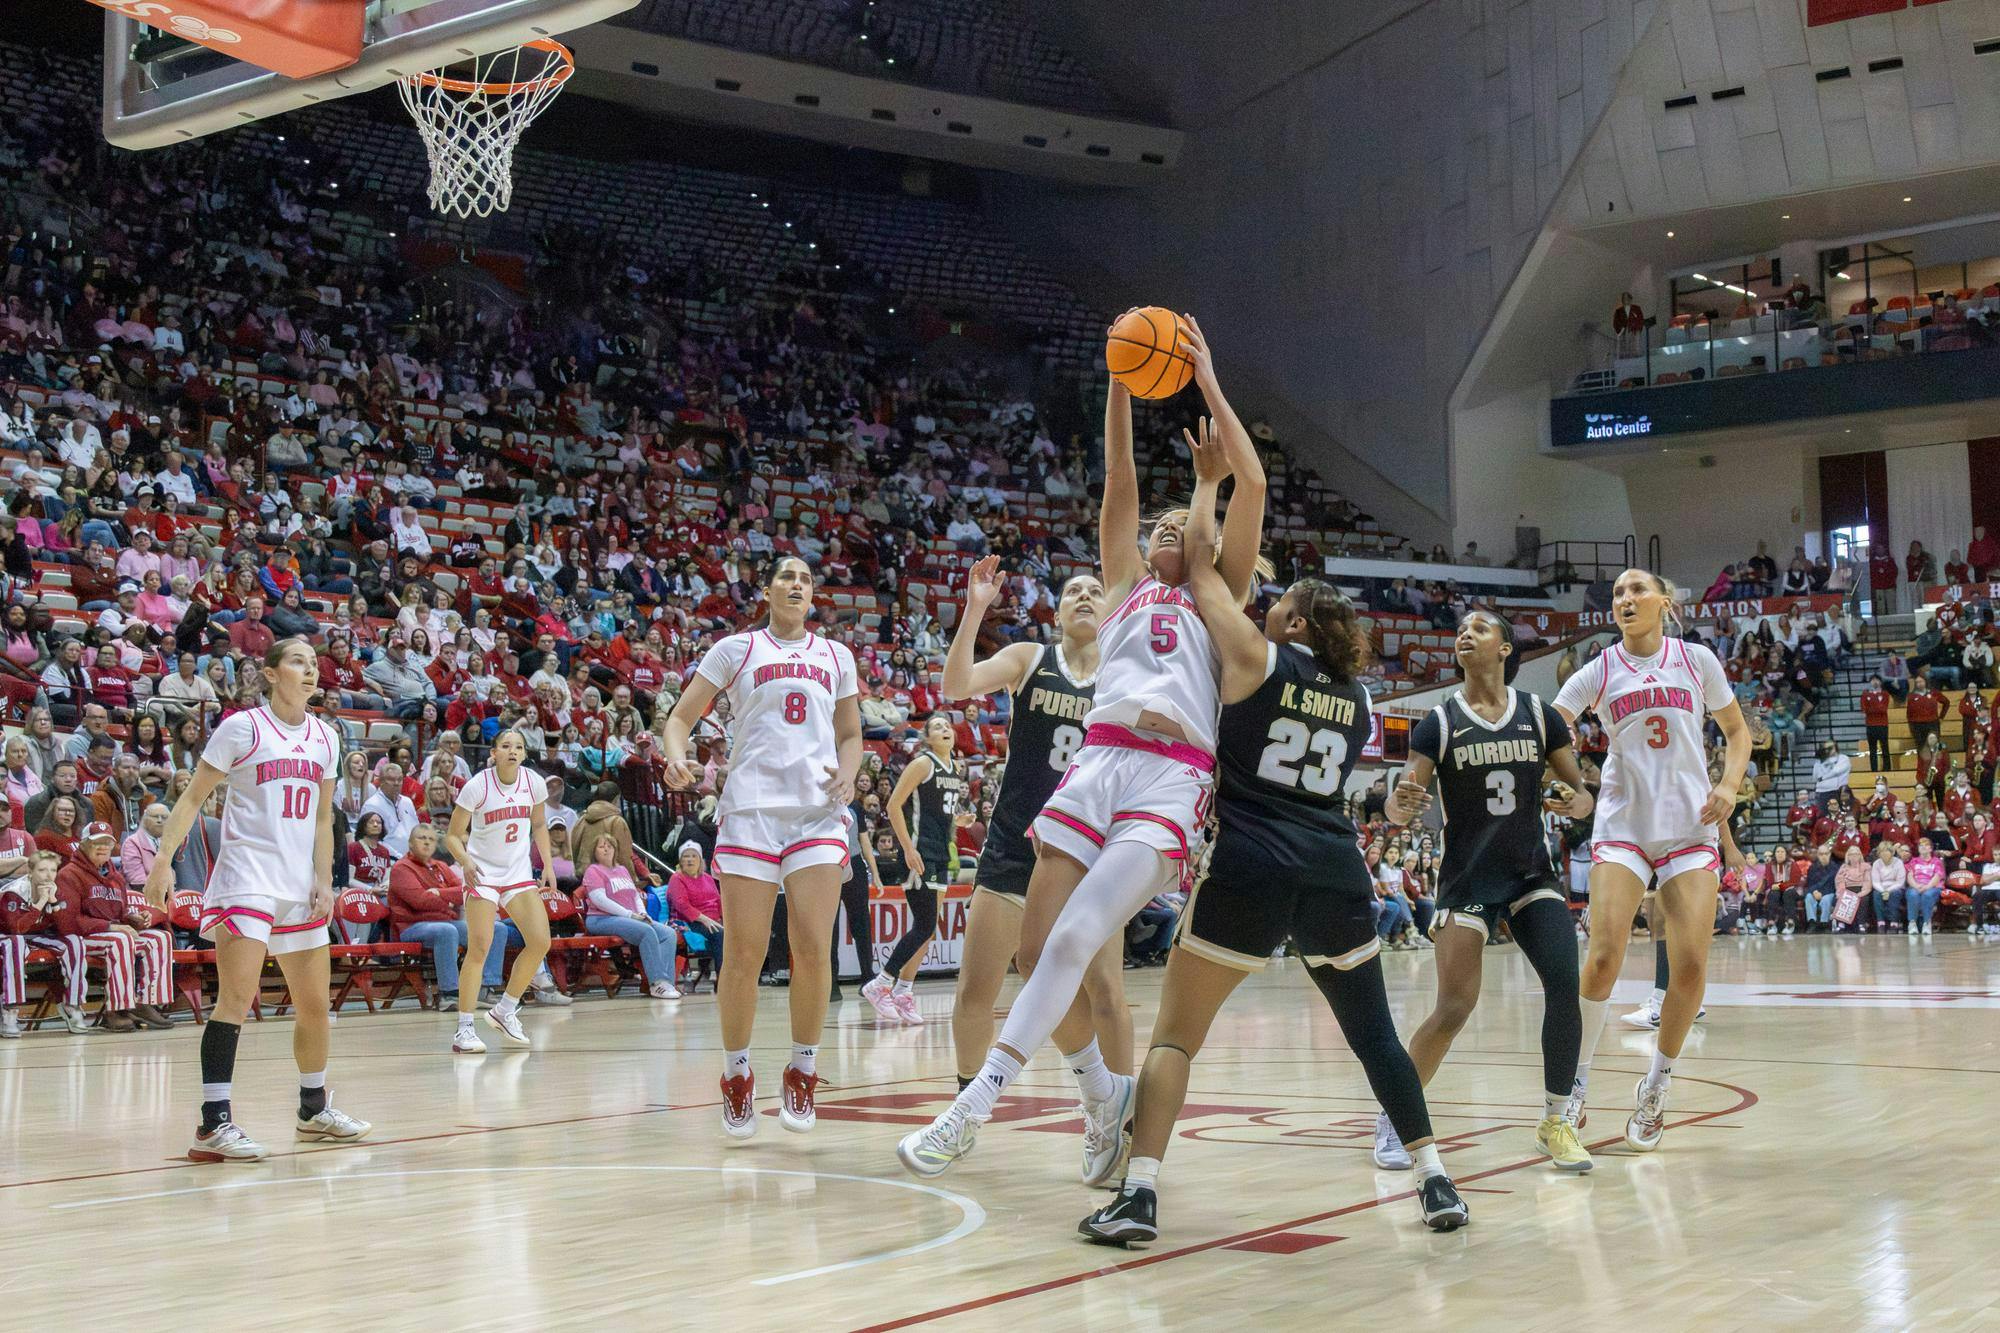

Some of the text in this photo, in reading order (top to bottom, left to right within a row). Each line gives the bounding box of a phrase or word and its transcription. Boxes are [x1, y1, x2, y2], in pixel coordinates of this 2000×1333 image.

[1586, 421, 1652, 438] Auto Center
[1684, 600, 1763, 619] NATION
[1151, 614, 1178, 654] 5
[753, 663, 832, 695] INDIANA
[784, 692, 807, 724] 8
[1029, 688, 1092, 723] PURD
[1280, 682, 1356, 726] K. SMITH
[1609, 687, 1693, 725] INDIANA
[1645, 715, 1670, 749] 3
[1049, 724, 1084, 773] 8
[1257, 717, 1348, 797] 23
[1453, 739, 1539, 771] PURDUE
[256, 758, 325, 786] INDIAN
[282, 785, 312, 820] 10
[1485, 769, 1517, 816] 3
[484, 805, 531, 825] INDIAN
[505, 823, 518, 844] 2
[175, 895, 208, 909] INDIAN
[344, 894, 380, 906] INDIANA
